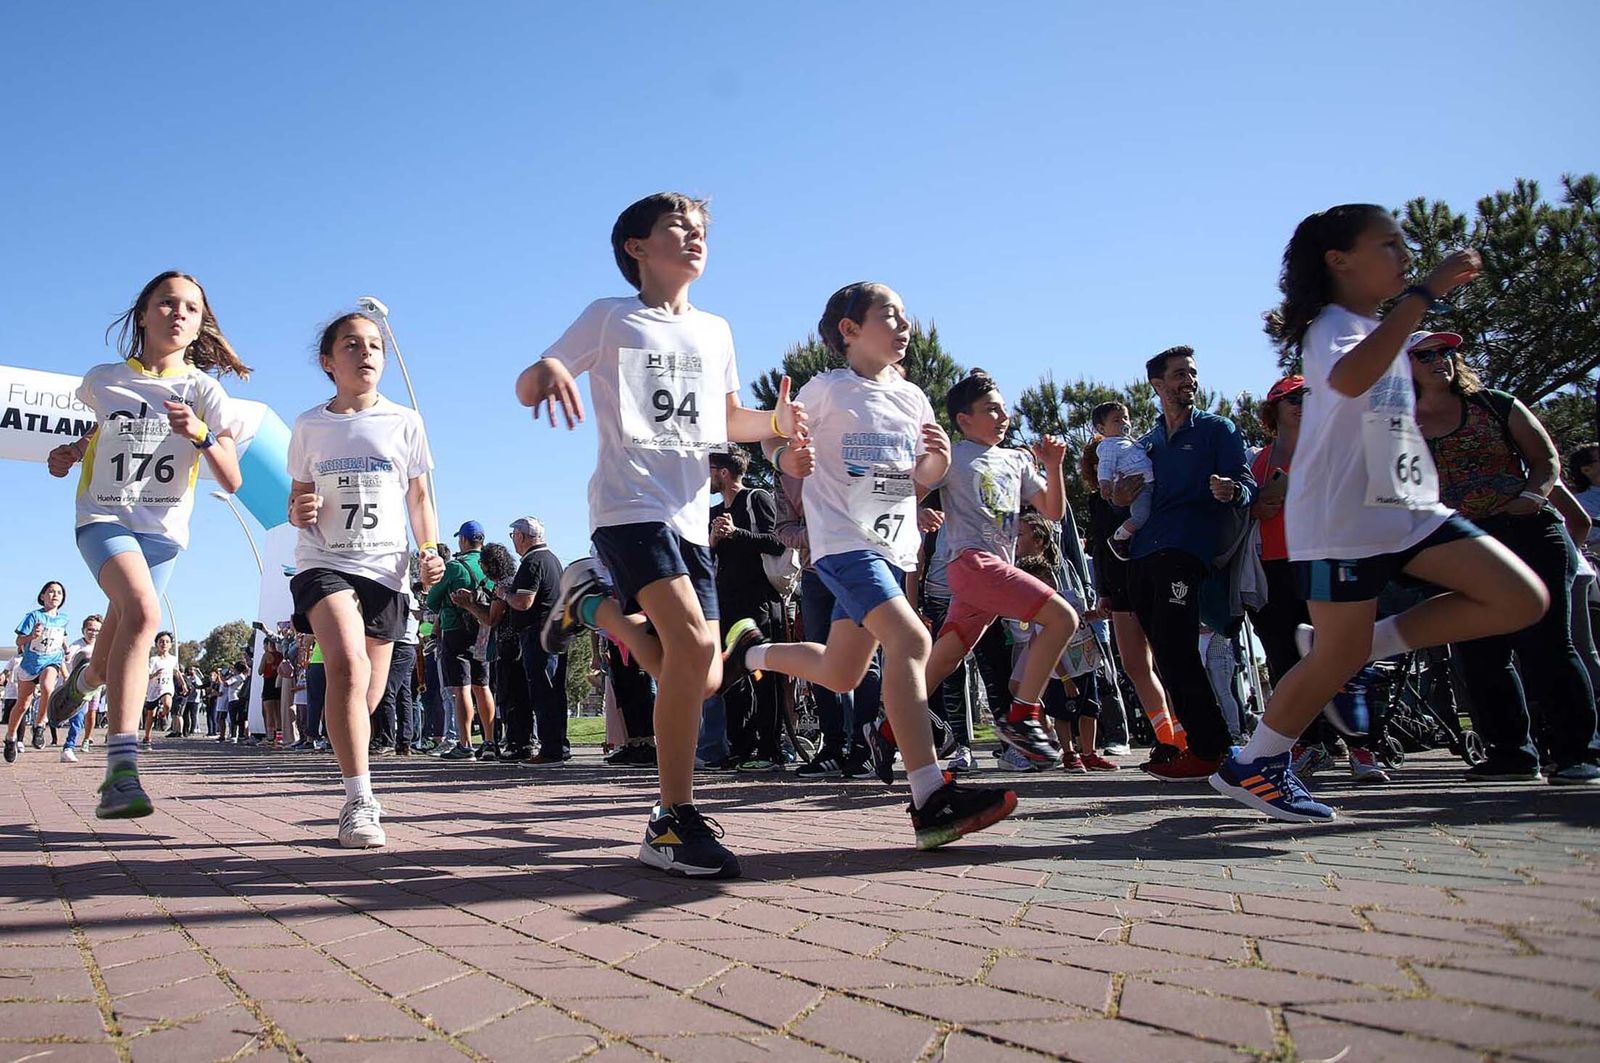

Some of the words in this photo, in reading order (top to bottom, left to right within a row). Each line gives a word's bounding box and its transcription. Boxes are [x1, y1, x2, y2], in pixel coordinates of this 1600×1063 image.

[8, 383, 96, 414] Funda
[652, 389, 699, 424] 94
[0, 407, 98, 437] ATLAN
[111, 453, 174, 483] 176
[1397, 453, 1422, 485] 66
[341, 503, 378, 529] 75
[874, 513, 905, 542] 67
[41, 638, 54, 647] 47
